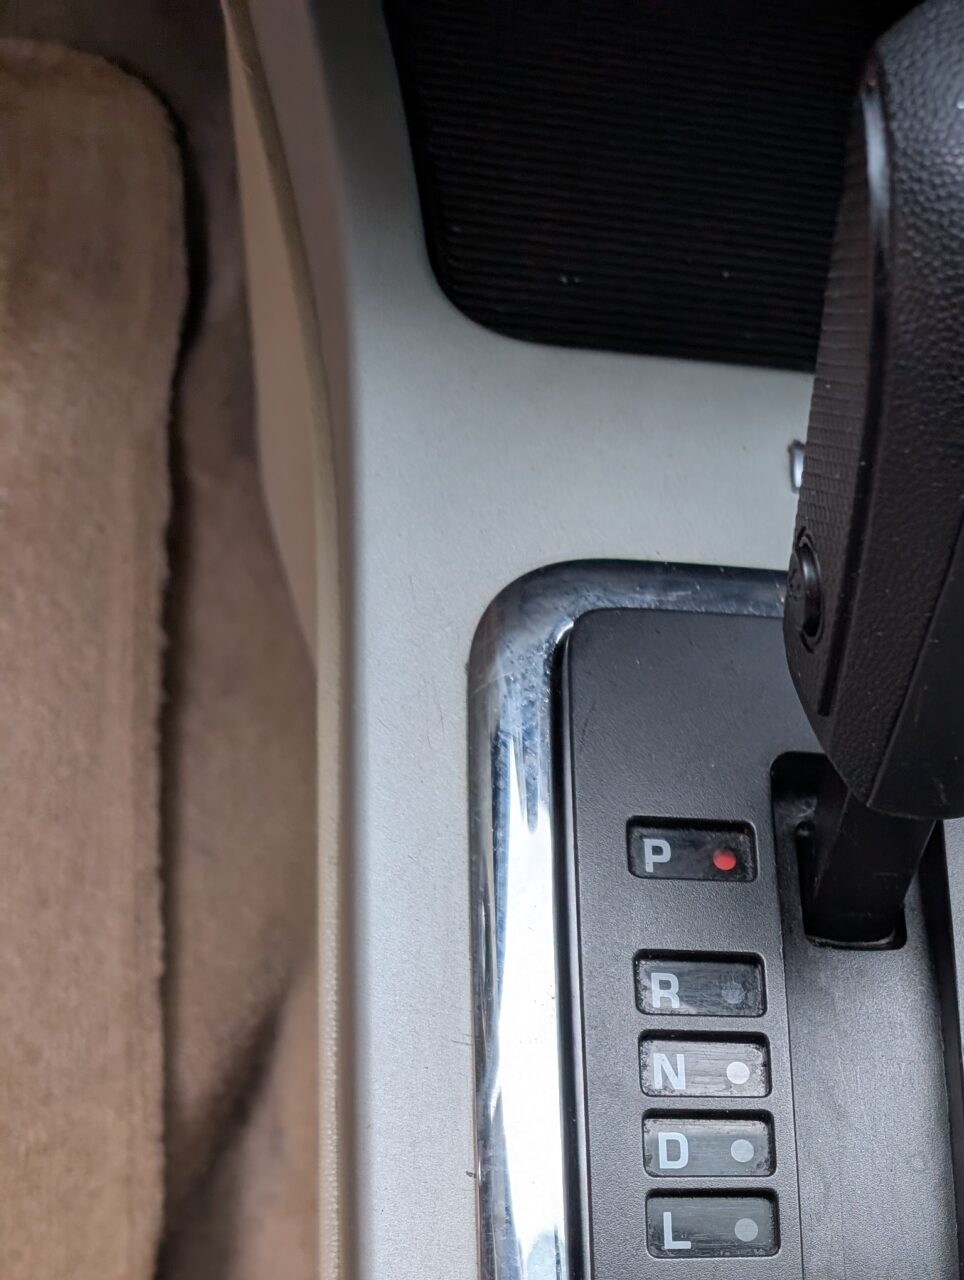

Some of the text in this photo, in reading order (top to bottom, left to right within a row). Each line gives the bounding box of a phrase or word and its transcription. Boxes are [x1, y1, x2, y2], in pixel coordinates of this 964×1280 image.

[643, 838, 672, 873] P
[650, 972, 681, 1009] R
[653, 1053, 686, 1090] N
[657, 1132, 689, 1169] D
[662, 1211, 692, 1250] L
